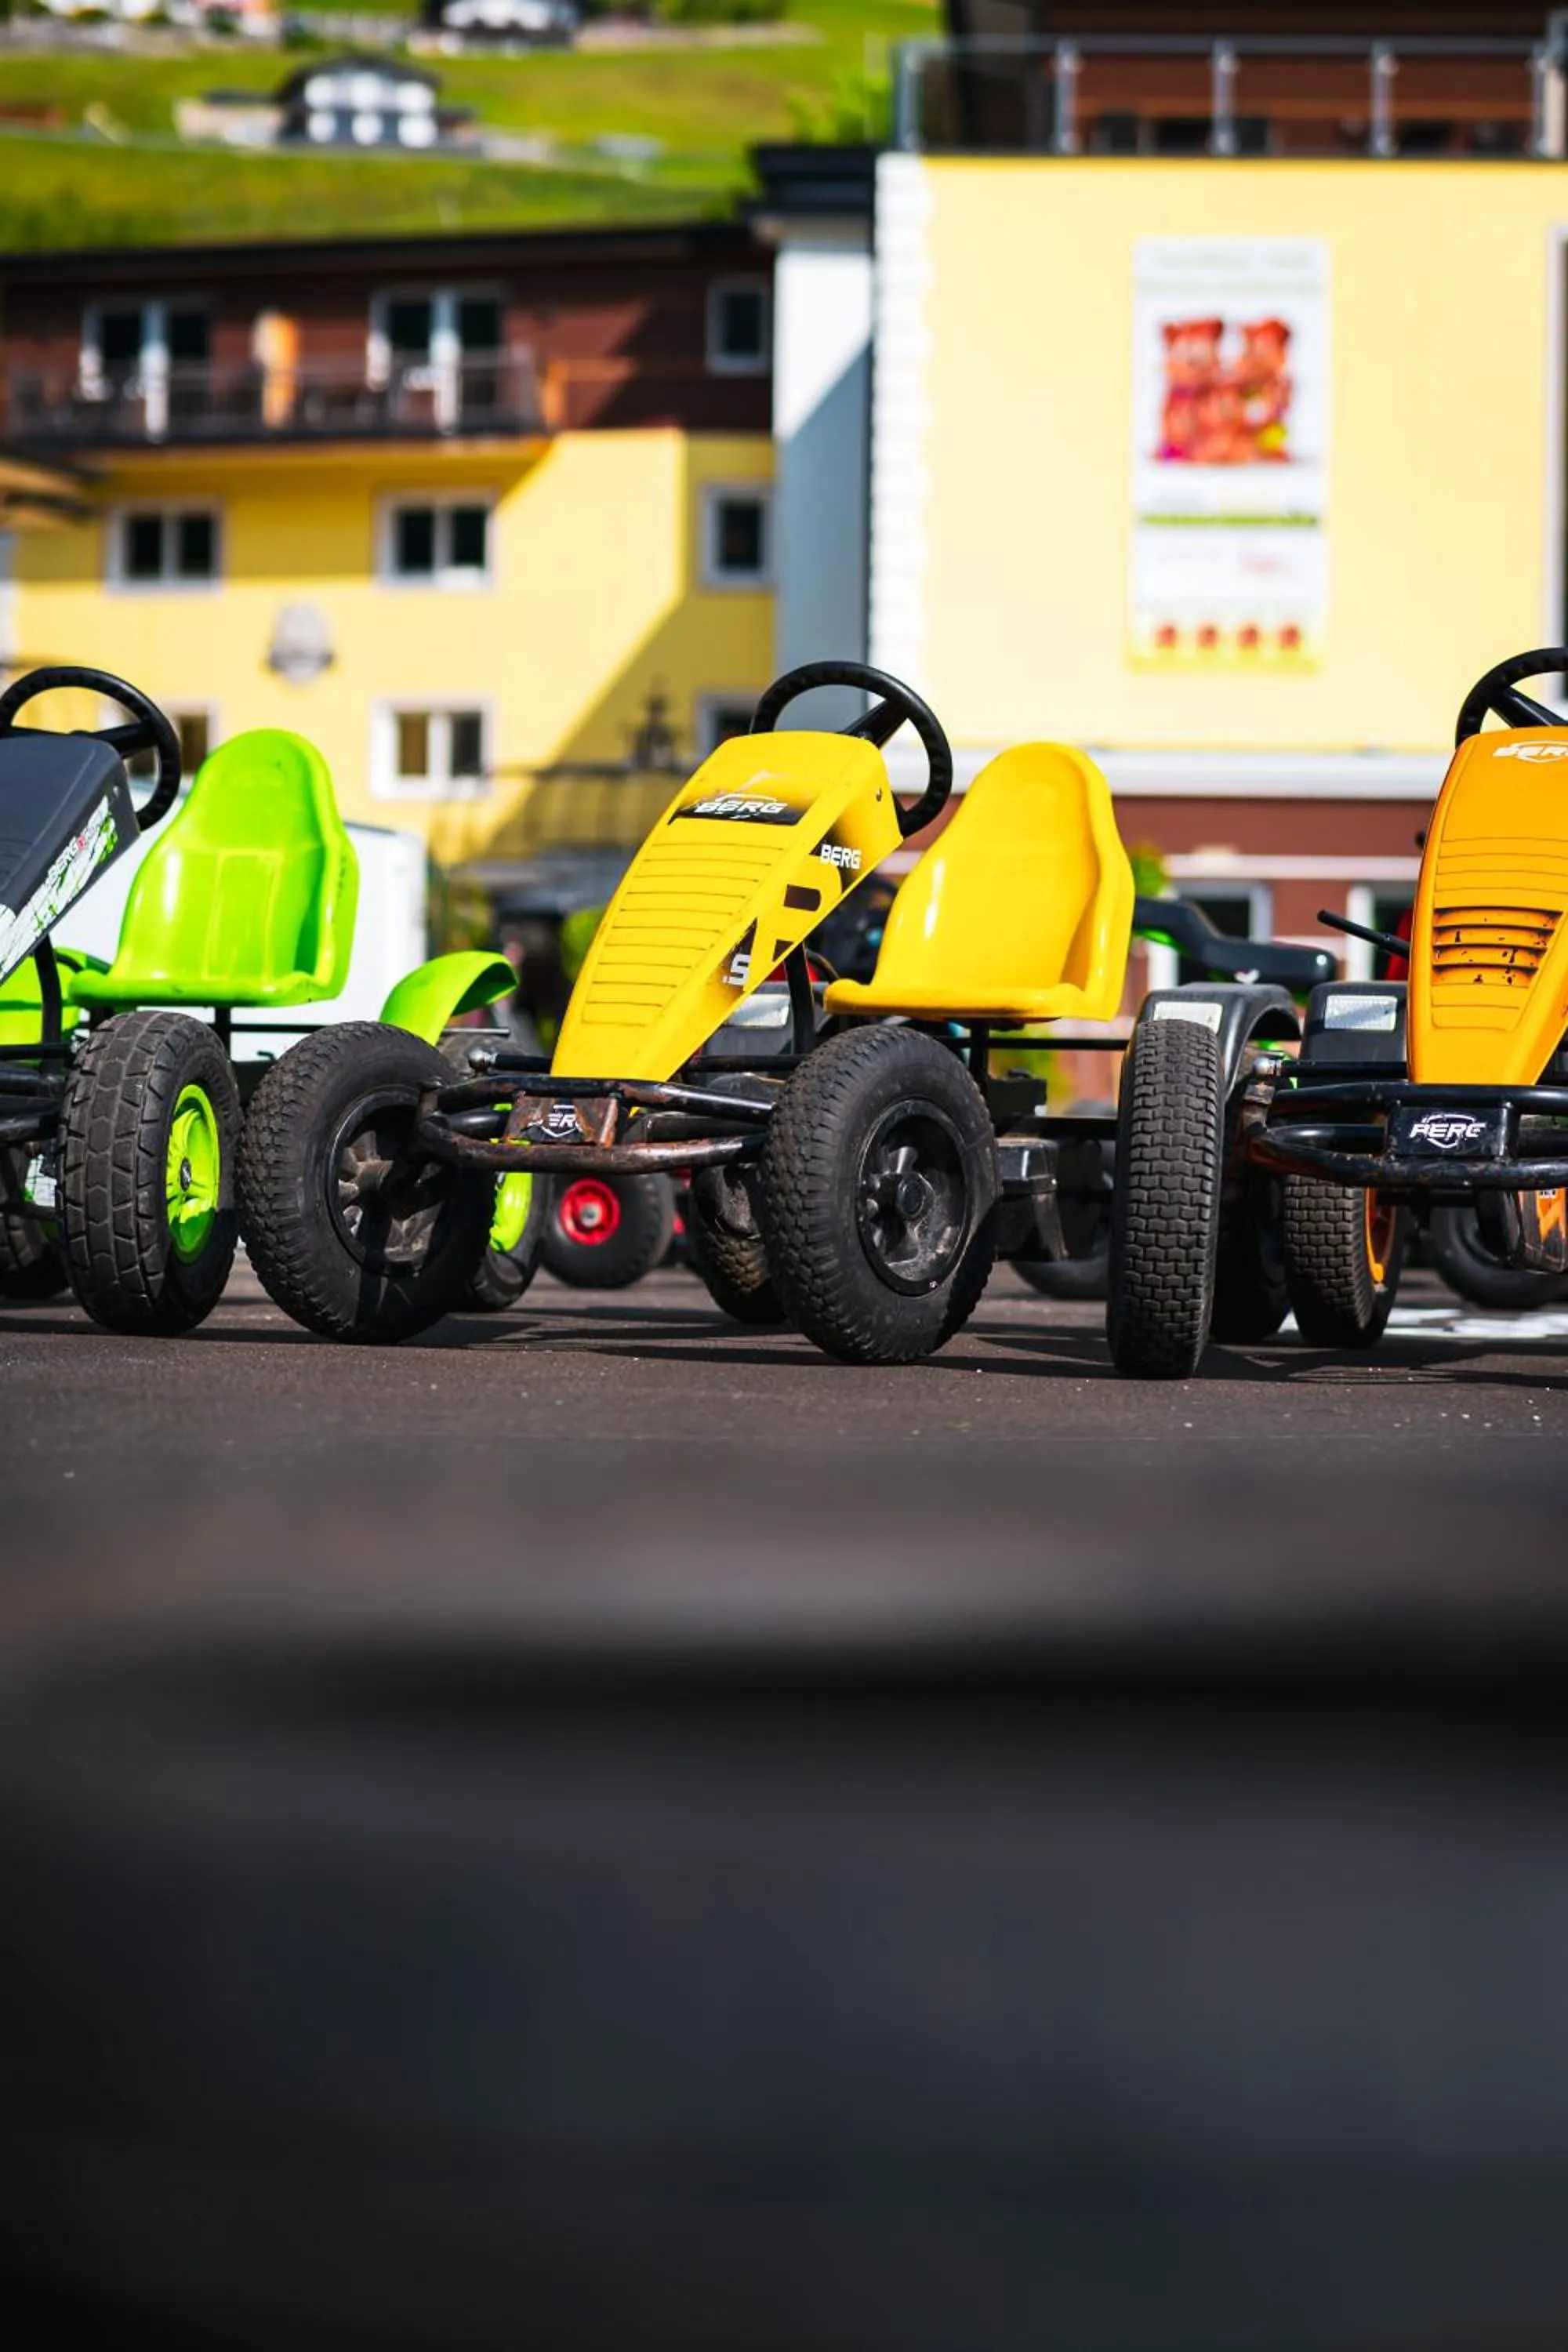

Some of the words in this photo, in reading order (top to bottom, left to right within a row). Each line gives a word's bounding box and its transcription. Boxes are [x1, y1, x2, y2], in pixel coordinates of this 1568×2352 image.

[1492, 746, 1568, 757] BER
[695, 800, 788, 814] BERG
[820, 844, 862, 869] BERG
